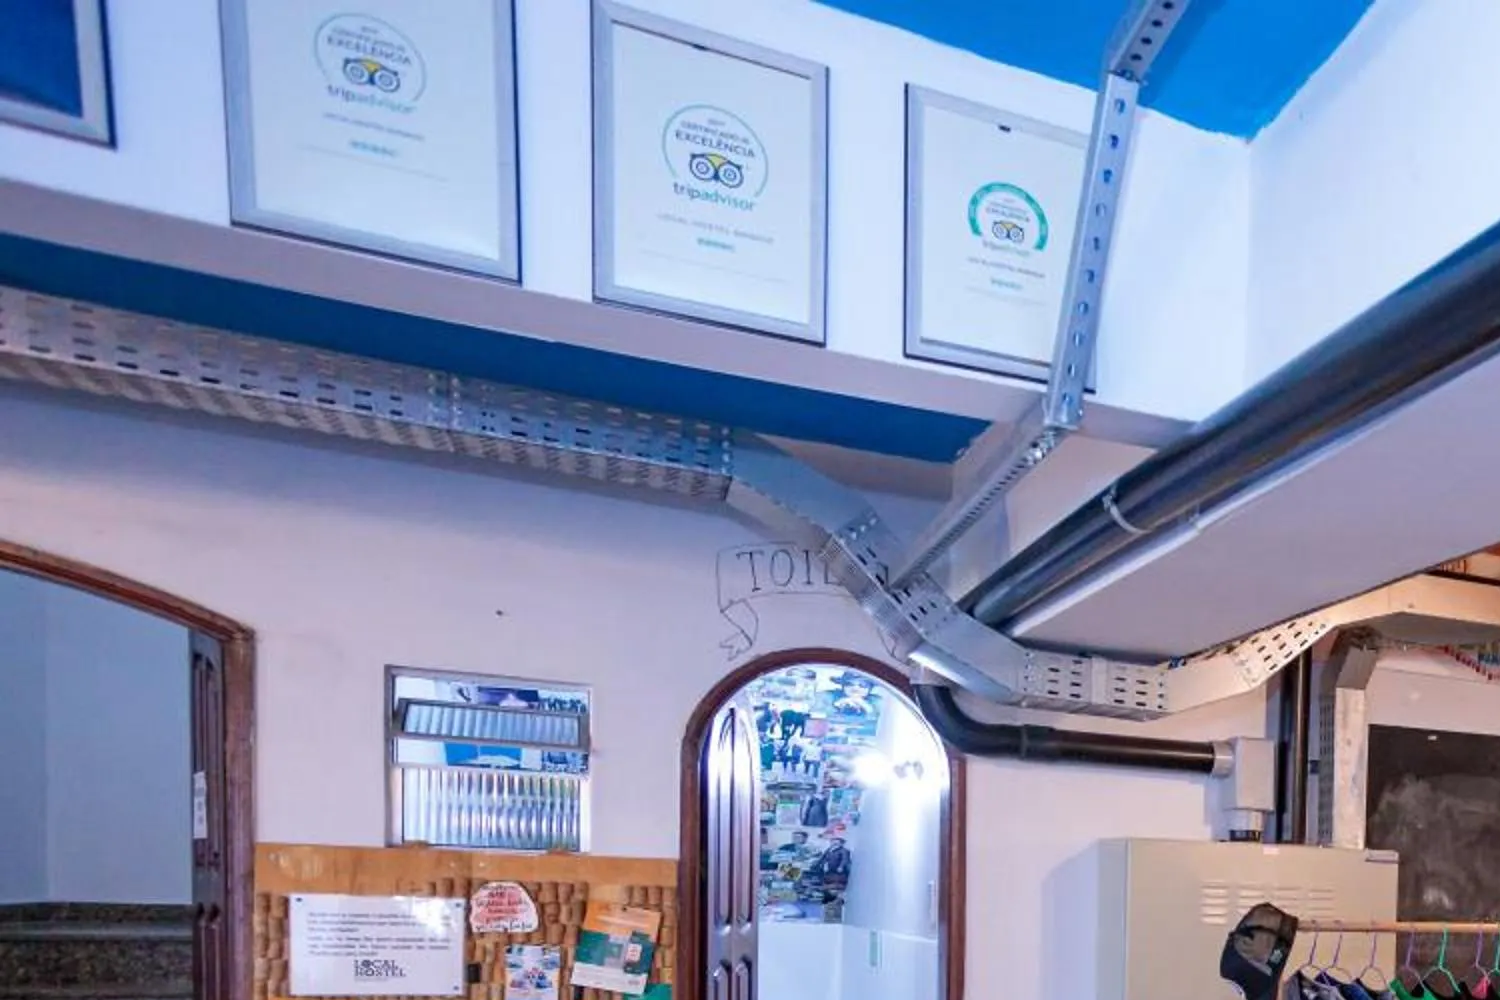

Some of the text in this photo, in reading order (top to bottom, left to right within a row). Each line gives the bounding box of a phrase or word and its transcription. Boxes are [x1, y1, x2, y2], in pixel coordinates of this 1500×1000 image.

[673, 181, 756, 212] tripadvisor
[735, 548, 848, 592] TOIL
[354, 959, 398, 970] LOCAL
